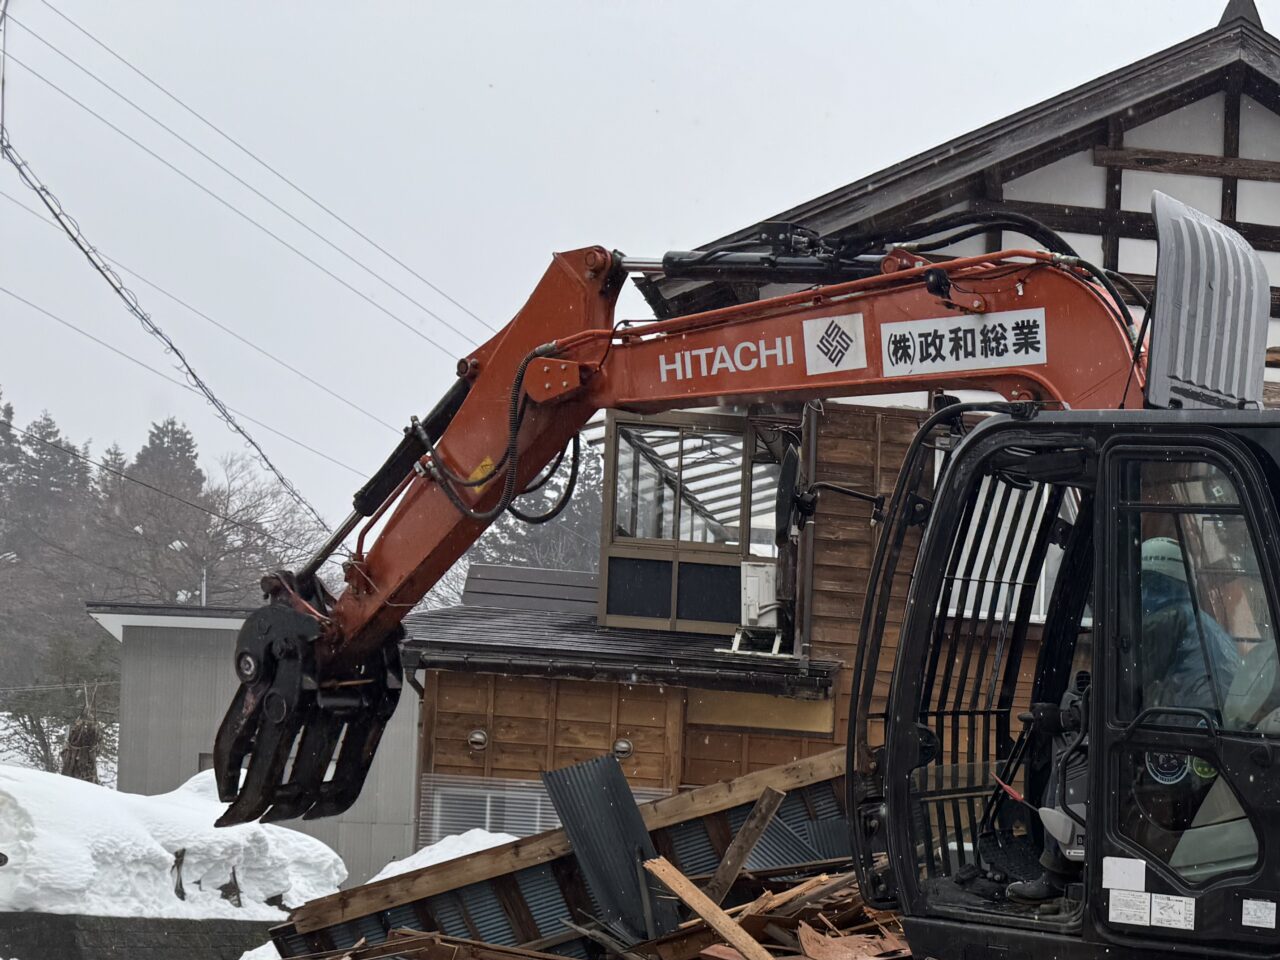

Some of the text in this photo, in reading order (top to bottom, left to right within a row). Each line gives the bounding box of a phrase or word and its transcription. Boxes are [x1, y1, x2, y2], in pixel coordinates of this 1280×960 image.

[659, 336, 794, 382] HITACHI
[888, 319, 1041, 366] (株)政和総業
